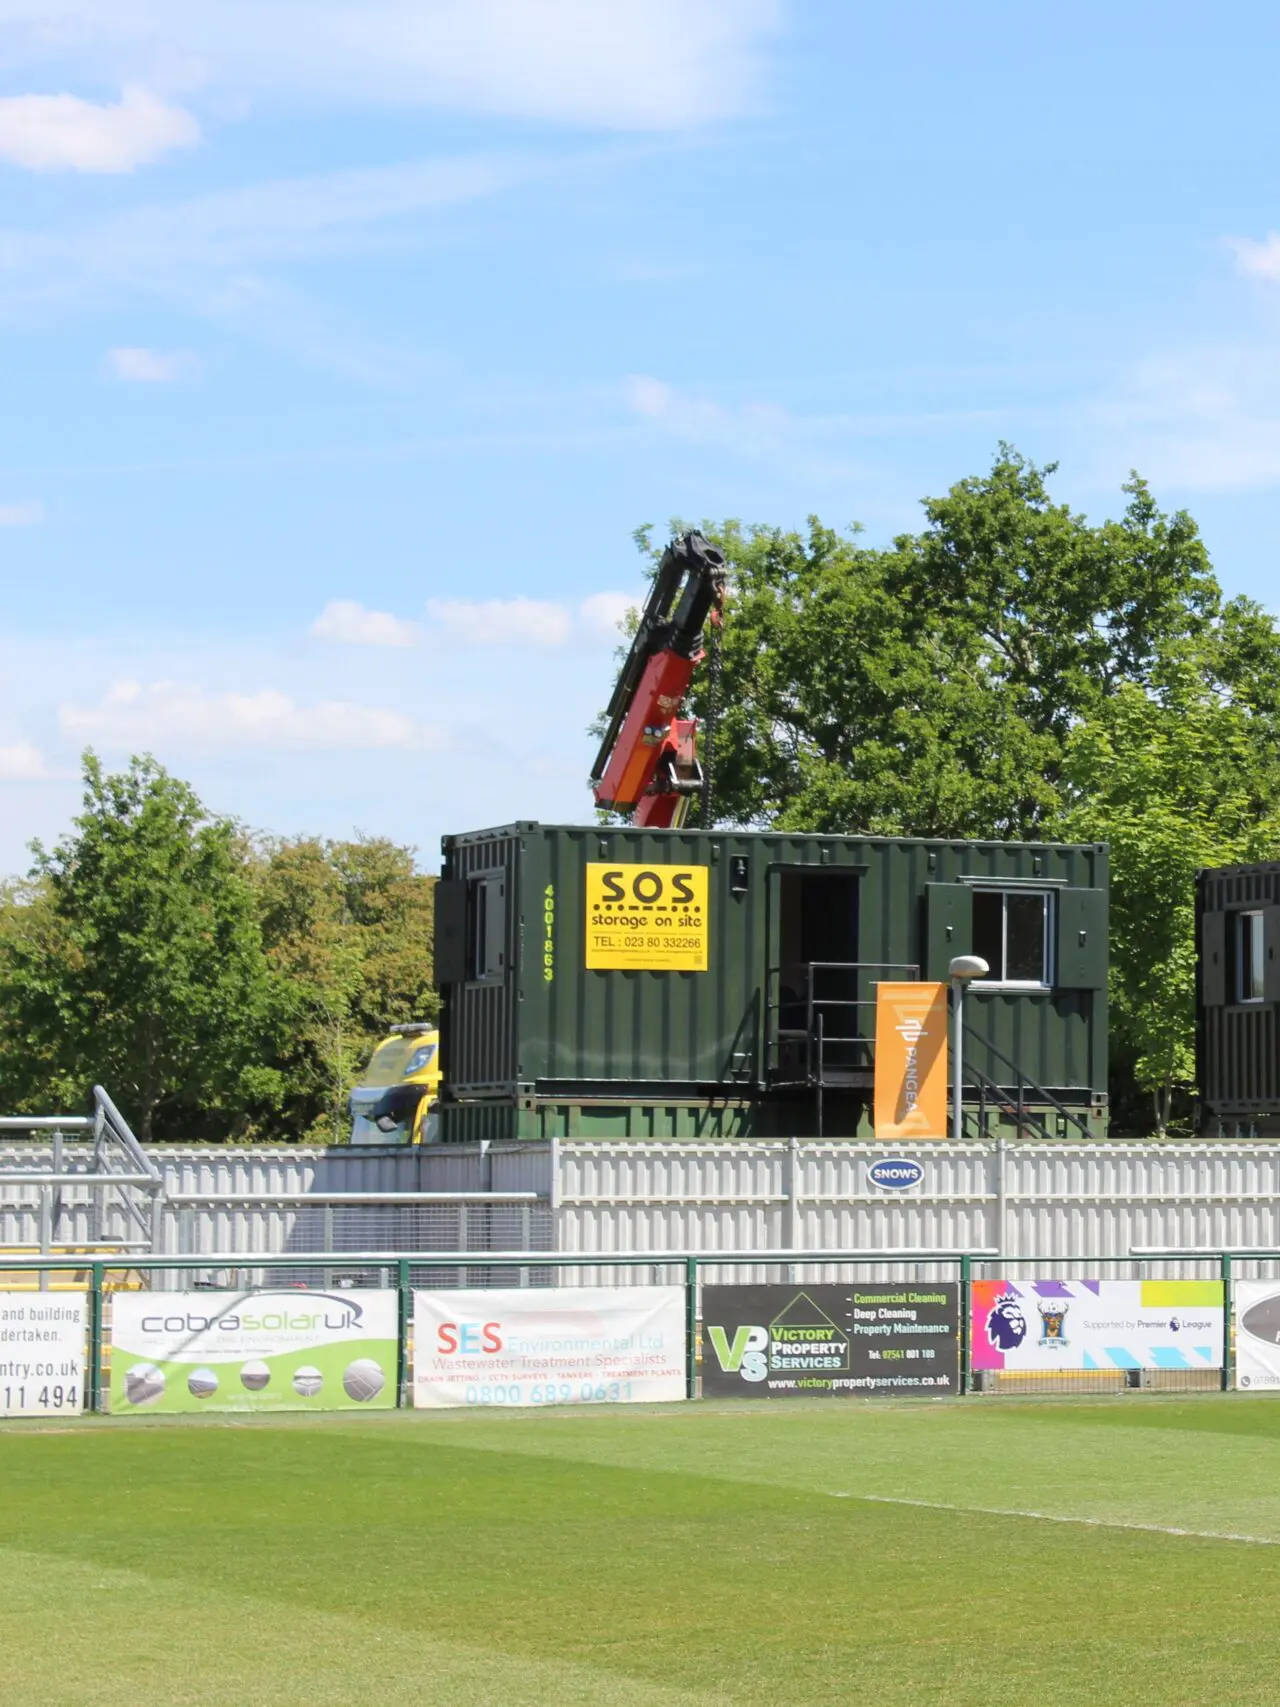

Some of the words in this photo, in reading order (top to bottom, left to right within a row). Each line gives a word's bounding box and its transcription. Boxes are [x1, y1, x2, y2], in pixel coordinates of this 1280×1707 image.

[601, 871, 695, 904] SOS
[592, 913, 648, 930] storage
[655, 918, 672, 927] on
[678, 914, 702, 928] site
[544, 884, 554, 981] 4001863
[594, 936, 616, 947] TEL
[625, 936, 644, 947] 023
[647, 937, 660, 948] 80
[663, 937, 701, 949] 332266
[905, 1047, 918, 1112] PANGEA
[874, 1168, 919, 1179] SNOWS
[854, 1294, 906, 1304] Commercial
[909, 1293, 947, 1305] Cleaning
[2, 1308, 24, 1320] and
[29, 1308, 80, 1323] building
[854, 1309, 876, 1321] Deep
[878, 1308, 917, 1320] Cleaning
[854, 1324, 891, 1336] Property
[893, 1323, 950, 1334] Maintenance
[1083, 1319, 1124, 1330] Supported
[1125, 1319, 1136, 1331] by
[1137, 1319, 1167, 1329] Premier
[1182, 1319, 1212, 1330] League
[437, 1322, 502, 1354] SES
[508, 1333, 634, 1352] Environmental
[638, 1331, 664, 1349] Ltd
[771, 1328, 834, 1341] VICTORY
[772, 1342, 847, 1355] PROPERTY
[432, 1356, 514, 1370] Wastewater
[520, 1355, 591, 1368] Treatment
[595, 1353, 666, 1366] Specialists
[771, 1356, 842, 1369] SERVICES
[768, 1376, 950, 1389] www.victorypropertyservices.co.uk
[38, 1385, 77, 1408] 494
[466, 1385, 520, 1404] 0800
[530, 1384, 572, 1402] 689
[580, 1382, 632, 1401] 0631
